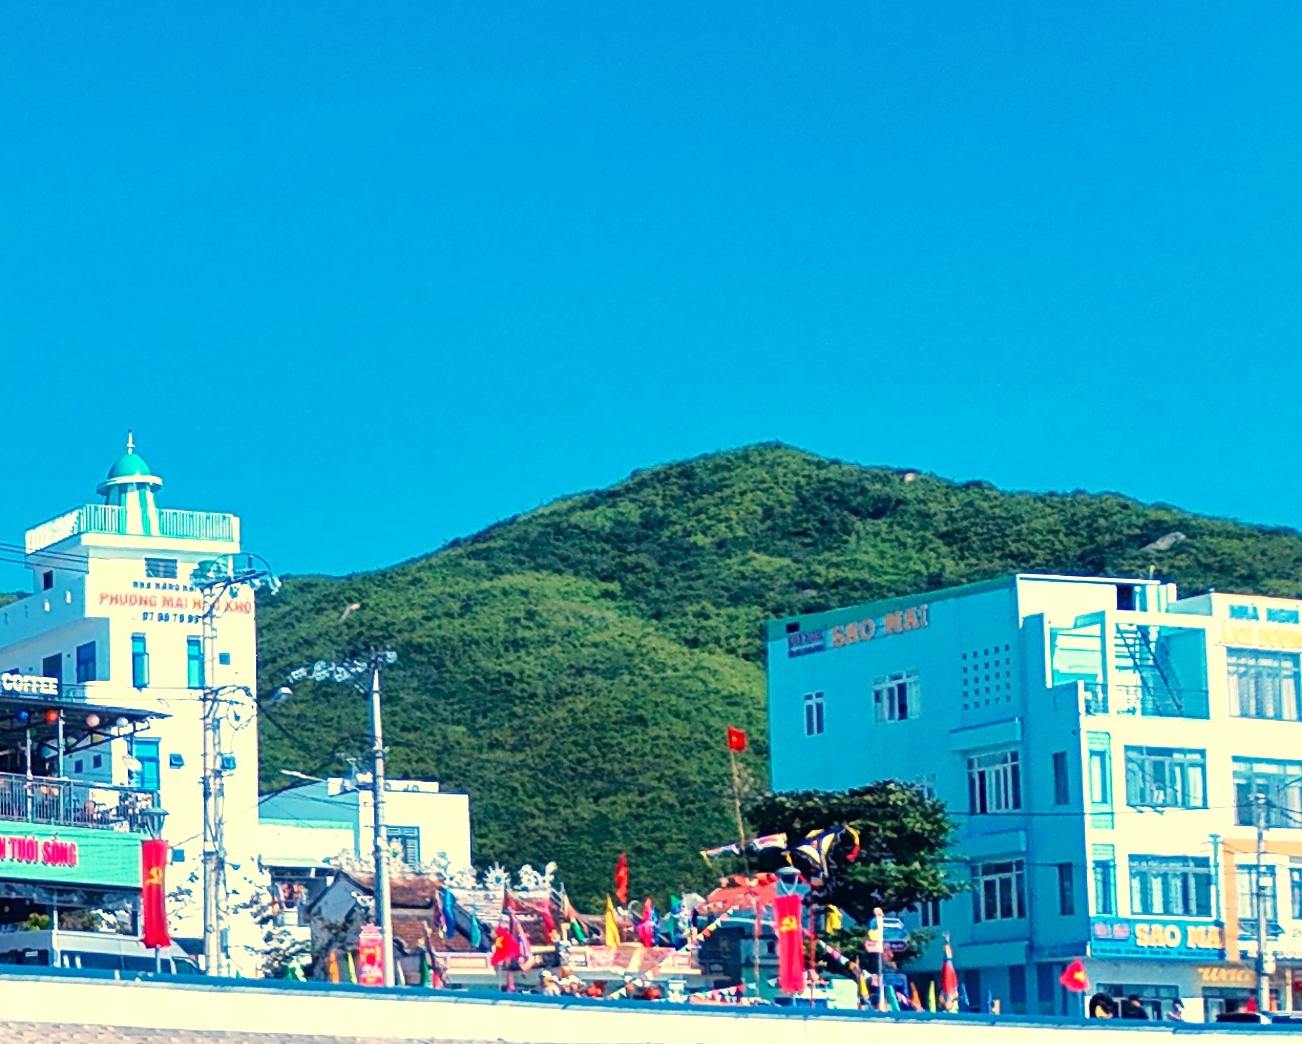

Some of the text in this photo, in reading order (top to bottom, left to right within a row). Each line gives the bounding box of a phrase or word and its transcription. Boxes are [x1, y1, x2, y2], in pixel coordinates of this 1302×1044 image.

[831, 618, 876, 648] SAO
[884, 604, 929, 635] MAI
[1, 672, 59, 695] COFFEE
[1135, 923, 1182, 949] SAO
